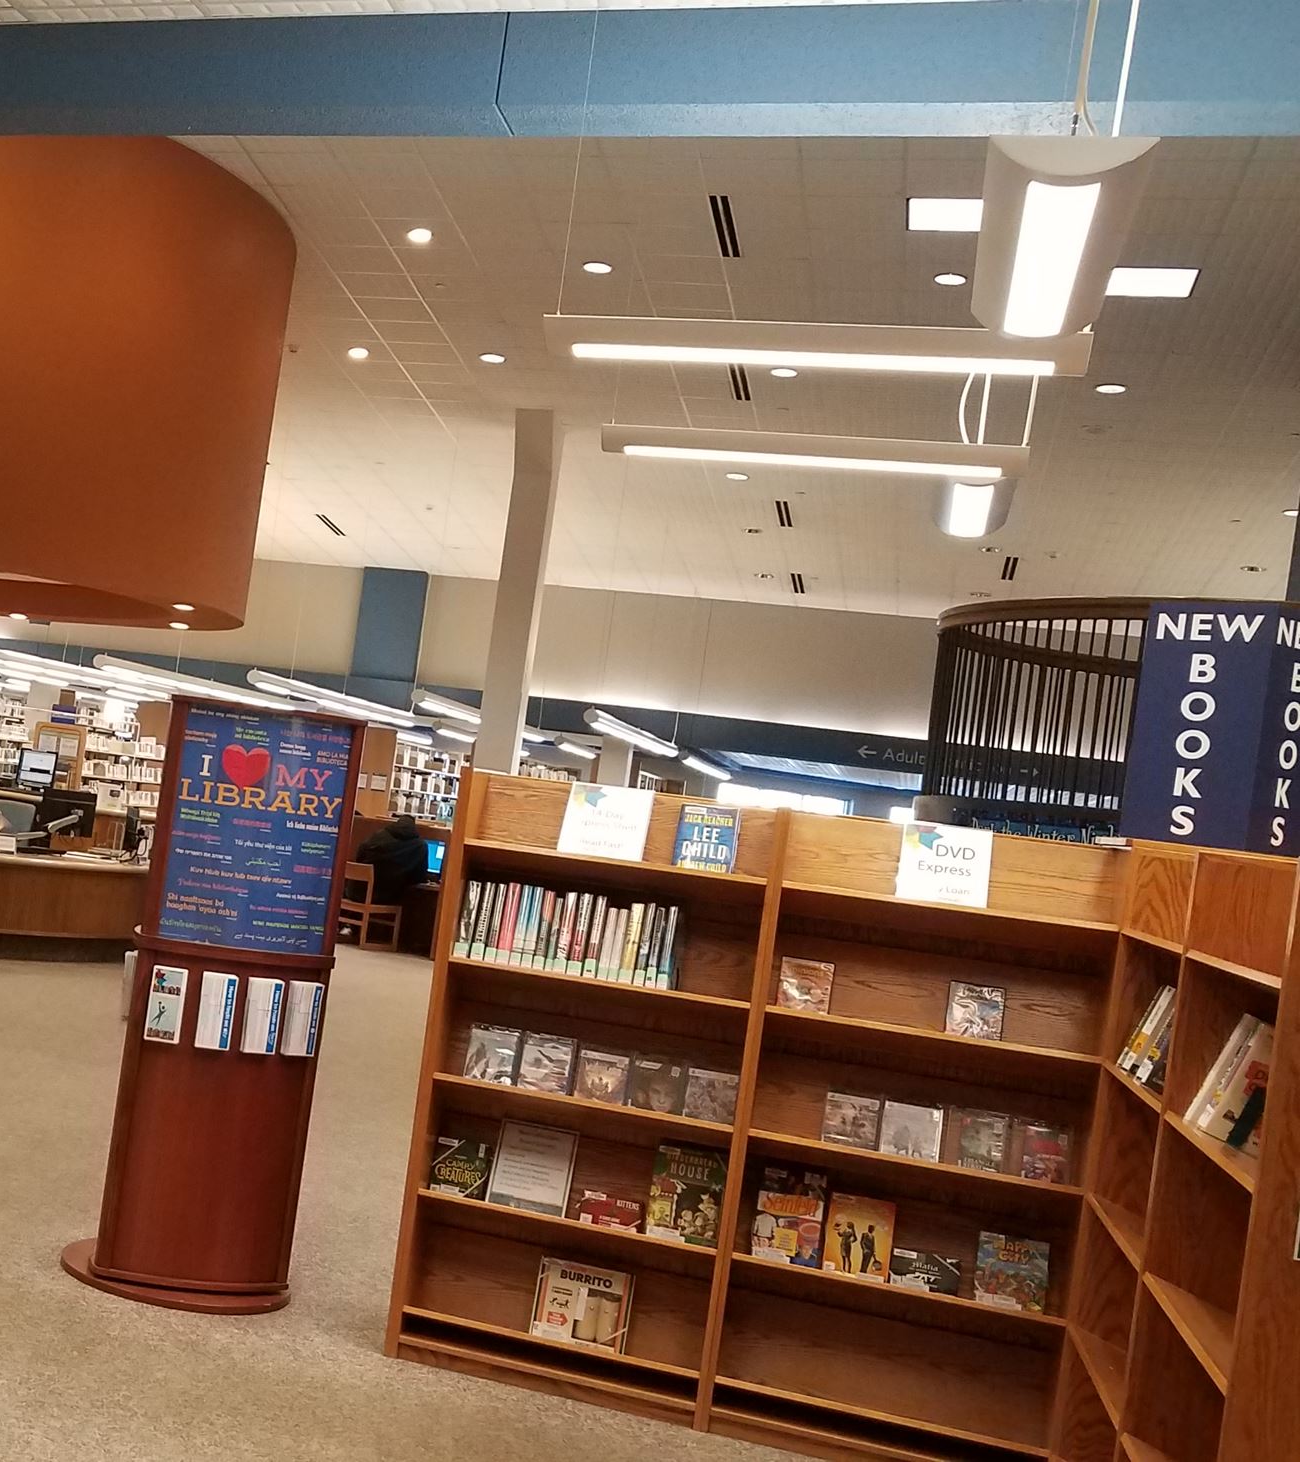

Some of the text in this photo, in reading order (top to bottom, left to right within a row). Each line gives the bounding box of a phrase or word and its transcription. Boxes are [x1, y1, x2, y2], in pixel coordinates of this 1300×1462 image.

[1156, 613, 1265, 642] NEW
[1276, 617, 1300, 650] NE
[1169, 653, 1216, 836] BOOKS
[199, 754, 213, 777] I
[276, 763, 332, 791] MY
[178, 778, 342, 819] LIBRARY
[693, 826, 721, 843] LEE
[1027, 824, 1076, 843] Winter
[682, 840, 727, 861] CHILD
[935, 844, 976, 861] DVD
[917, 859, 972, 877] Express
[445, 1158, 475, 1170] CAMPY
[670, 1162, 711, 1181] HOUSE
[434, 1163, 482, 1186] CREATURES
[616, 1199, 640, 1211] KITTENS
[560, 1269, 613, 1289] BURRITO
